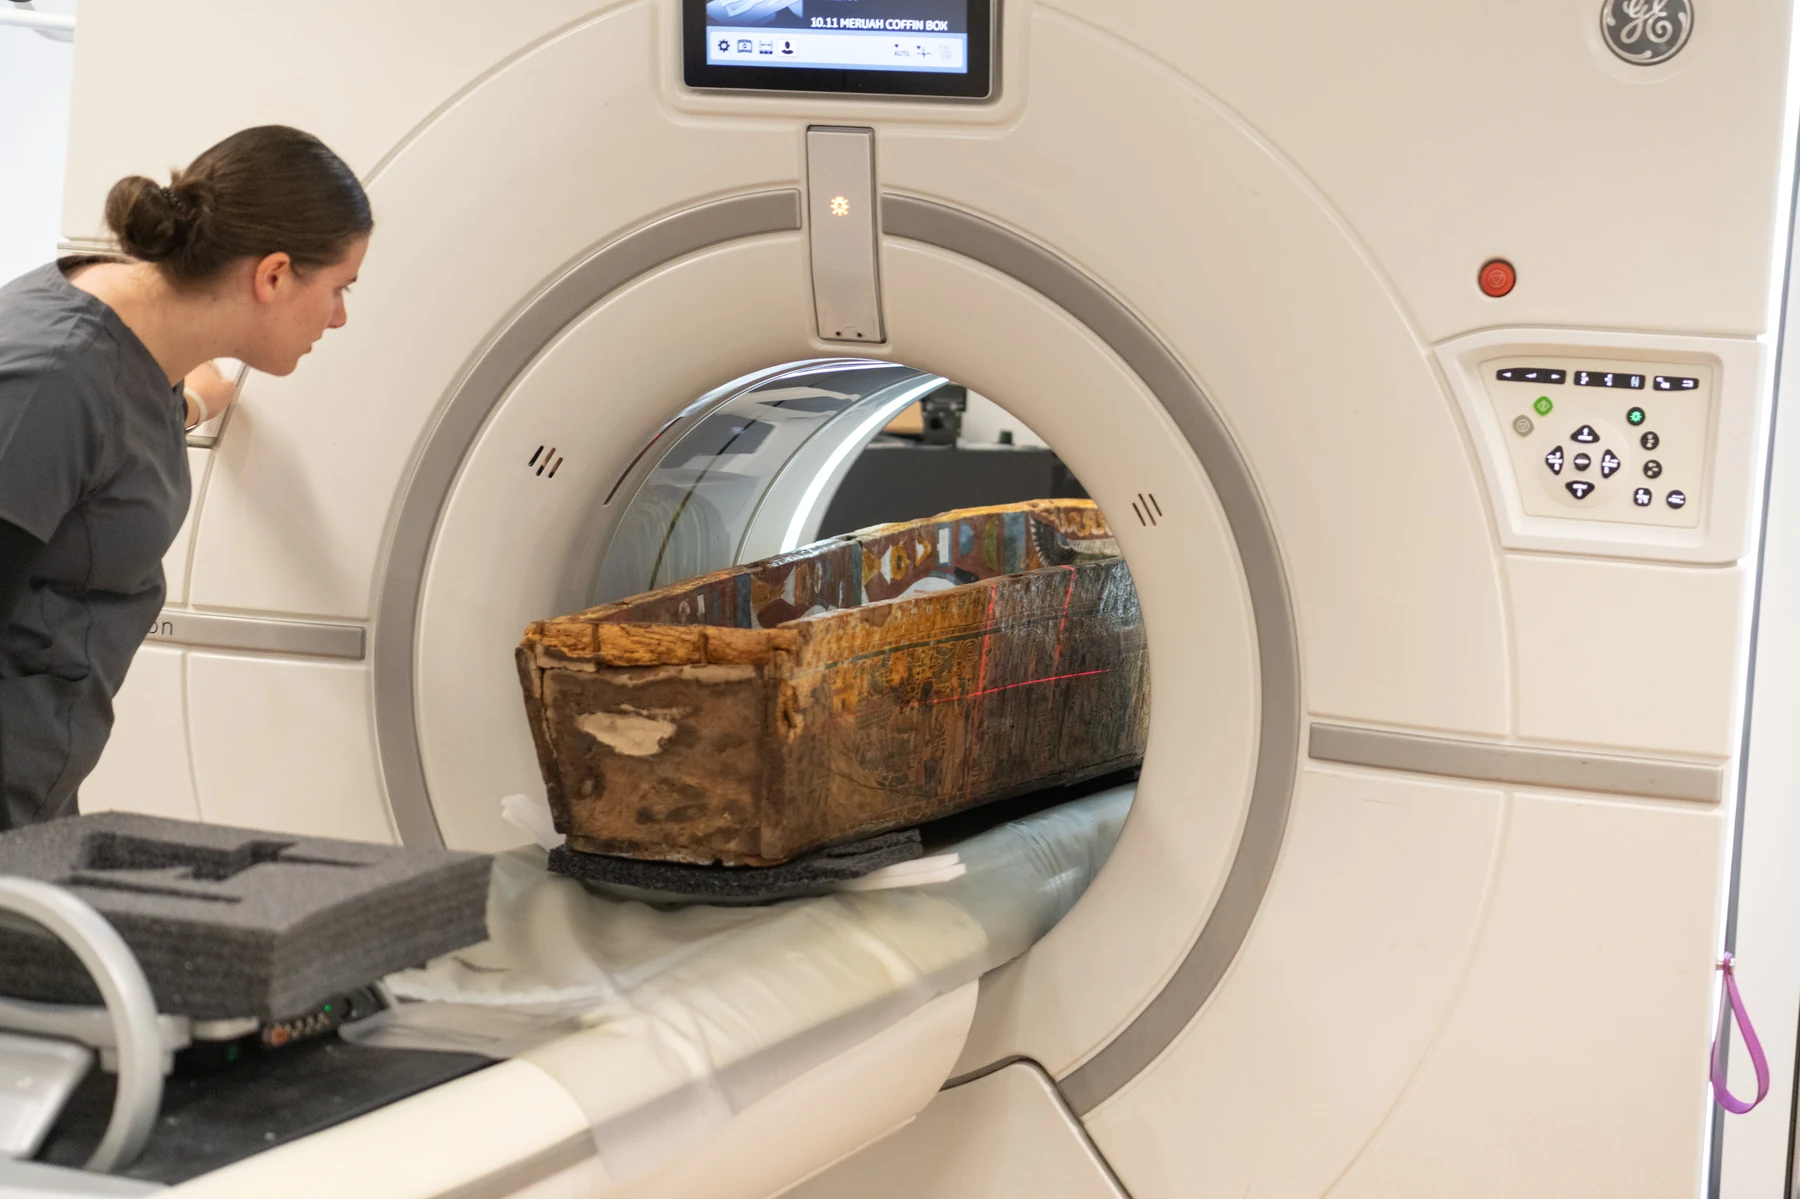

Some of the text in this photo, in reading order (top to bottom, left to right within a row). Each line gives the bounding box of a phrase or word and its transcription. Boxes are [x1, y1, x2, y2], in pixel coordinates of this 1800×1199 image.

[810, 17, 948, 31] 10.11 MERUAH COFFIN BOX
